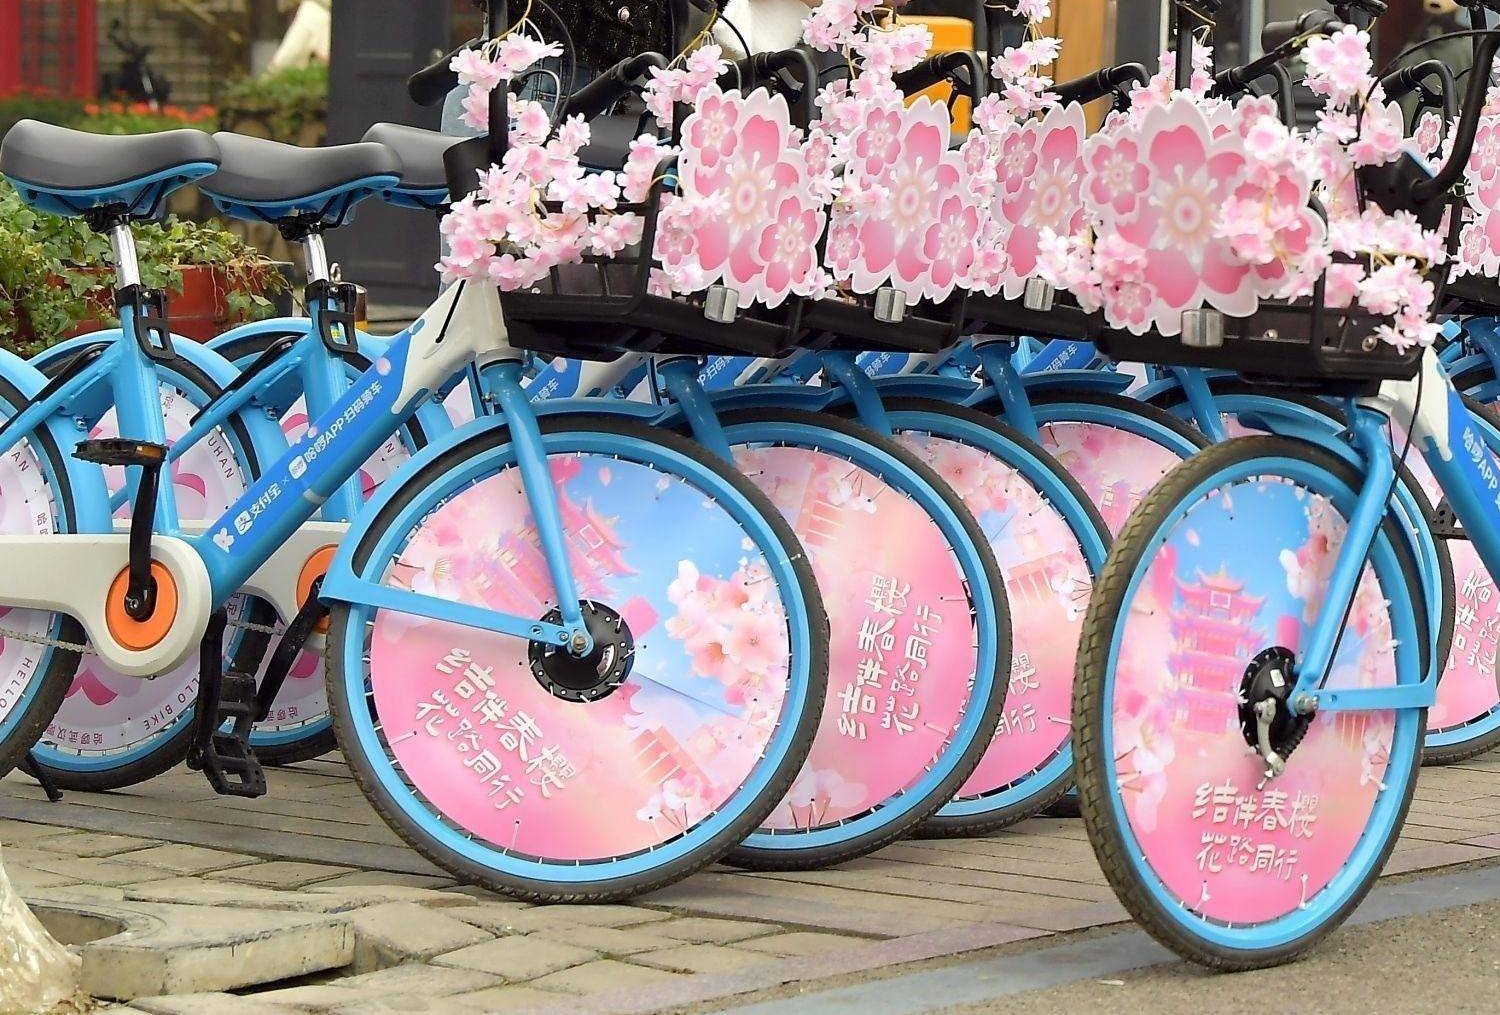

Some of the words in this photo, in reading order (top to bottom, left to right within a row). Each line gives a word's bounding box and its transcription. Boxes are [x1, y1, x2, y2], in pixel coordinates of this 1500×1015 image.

[207, 435, 235, 479] UHAN
[1196, 831, 1298, 881] 花路同行
